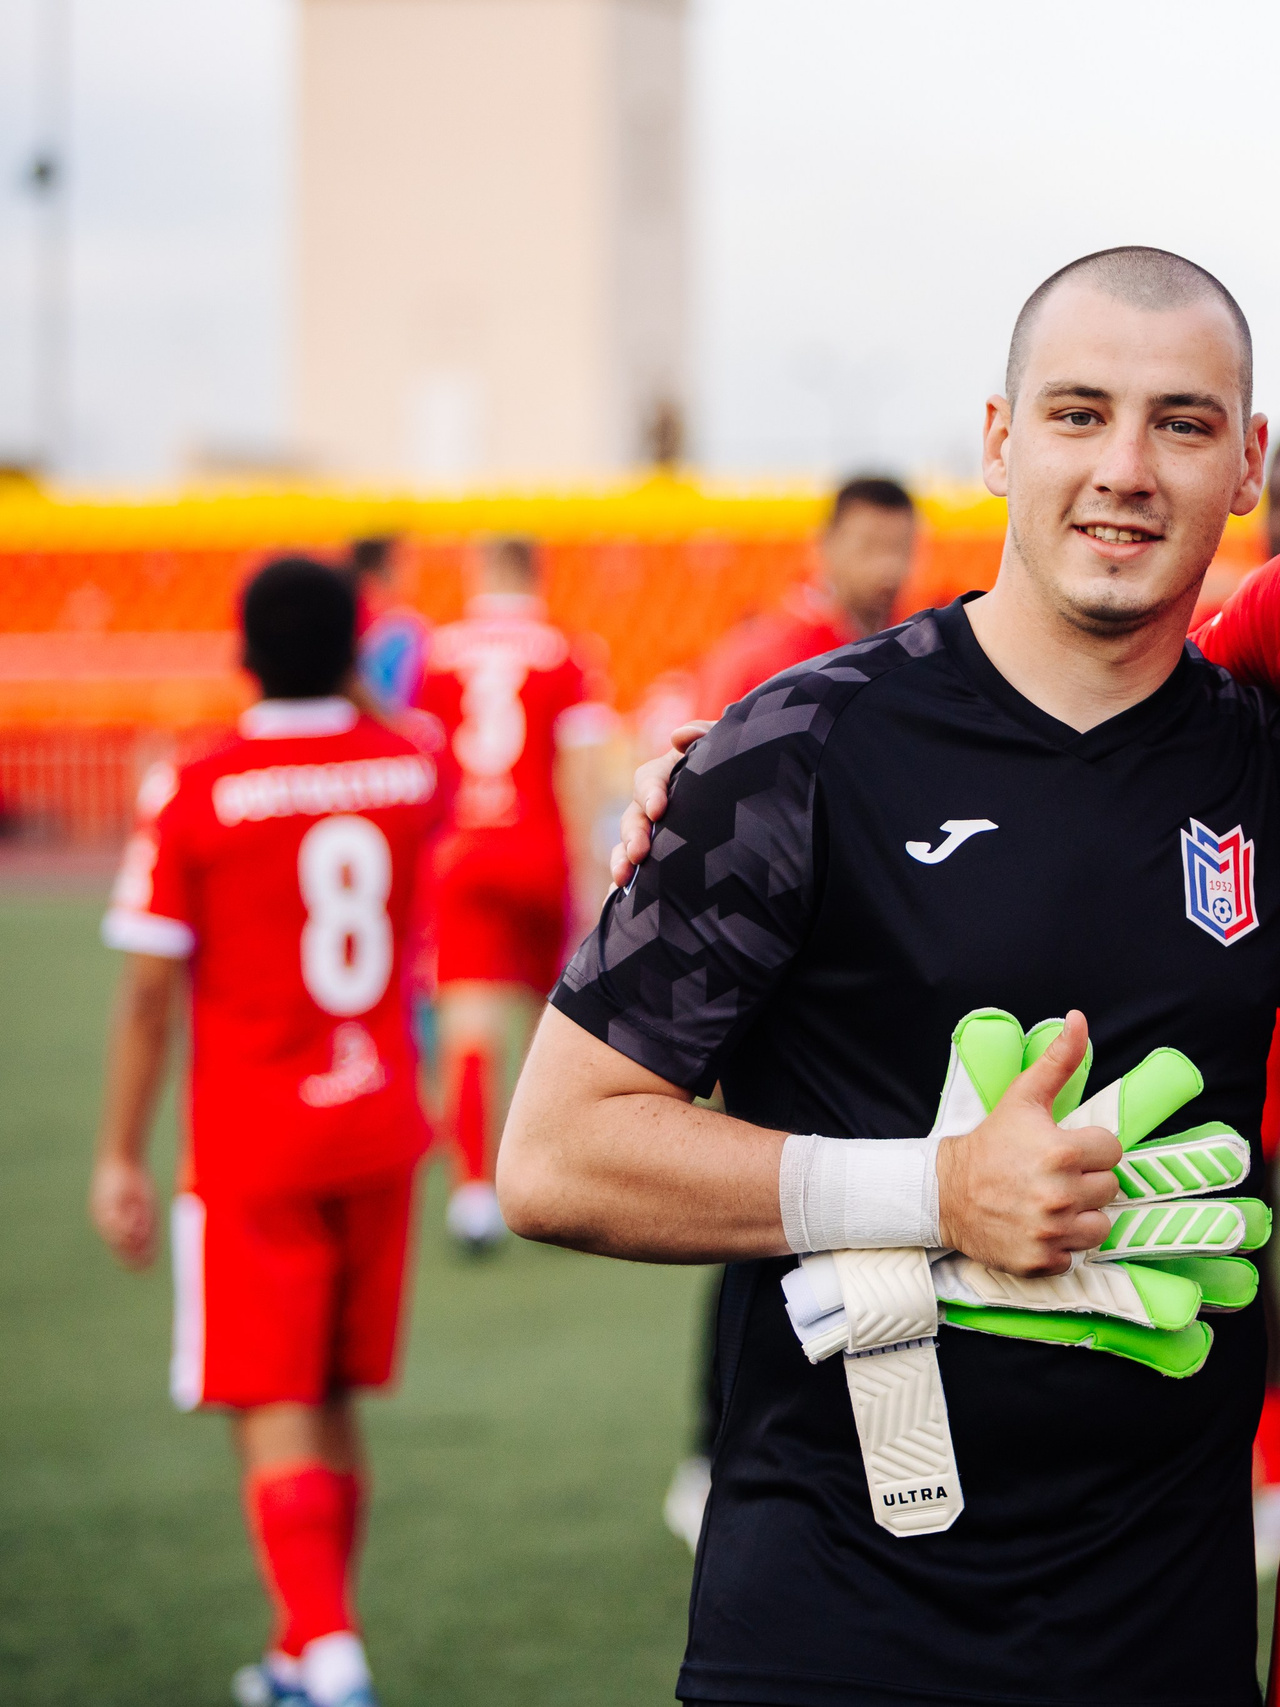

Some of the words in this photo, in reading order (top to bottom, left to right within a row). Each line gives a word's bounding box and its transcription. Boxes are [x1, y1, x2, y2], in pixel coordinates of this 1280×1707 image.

[1209, 880, 1233, 893] 1932
[297, 812, 394, 1018] 8
[883, 1486, 948, 1507] ULTRA
